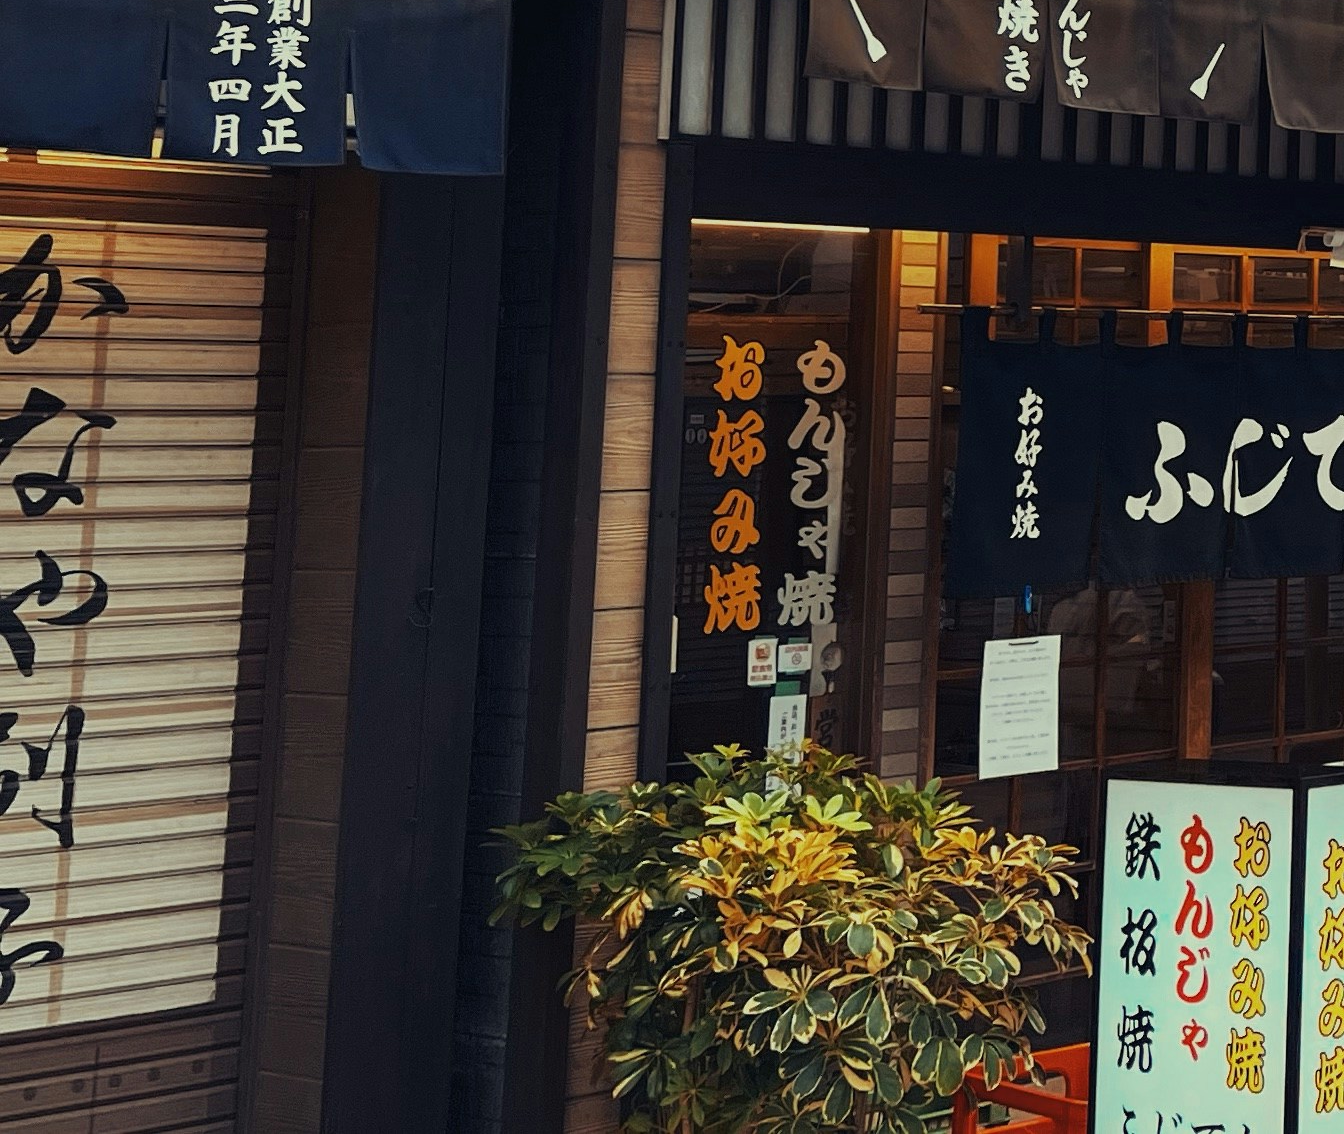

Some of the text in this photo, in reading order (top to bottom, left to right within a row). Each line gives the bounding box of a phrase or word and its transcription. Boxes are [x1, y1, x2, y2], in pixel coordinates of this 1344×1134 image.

[704, 335, 767, 635] お好み焼
[777, 340, 846, 626] もんじゃ焼
[1010, 387, 1044, 539] お好み焼
[1117, 811, 1161, 1073] 鉄板焼
[1175, 814, 1214, 1061] もんじゃ
[1226, 816, 1271, 1094] お好み焼
